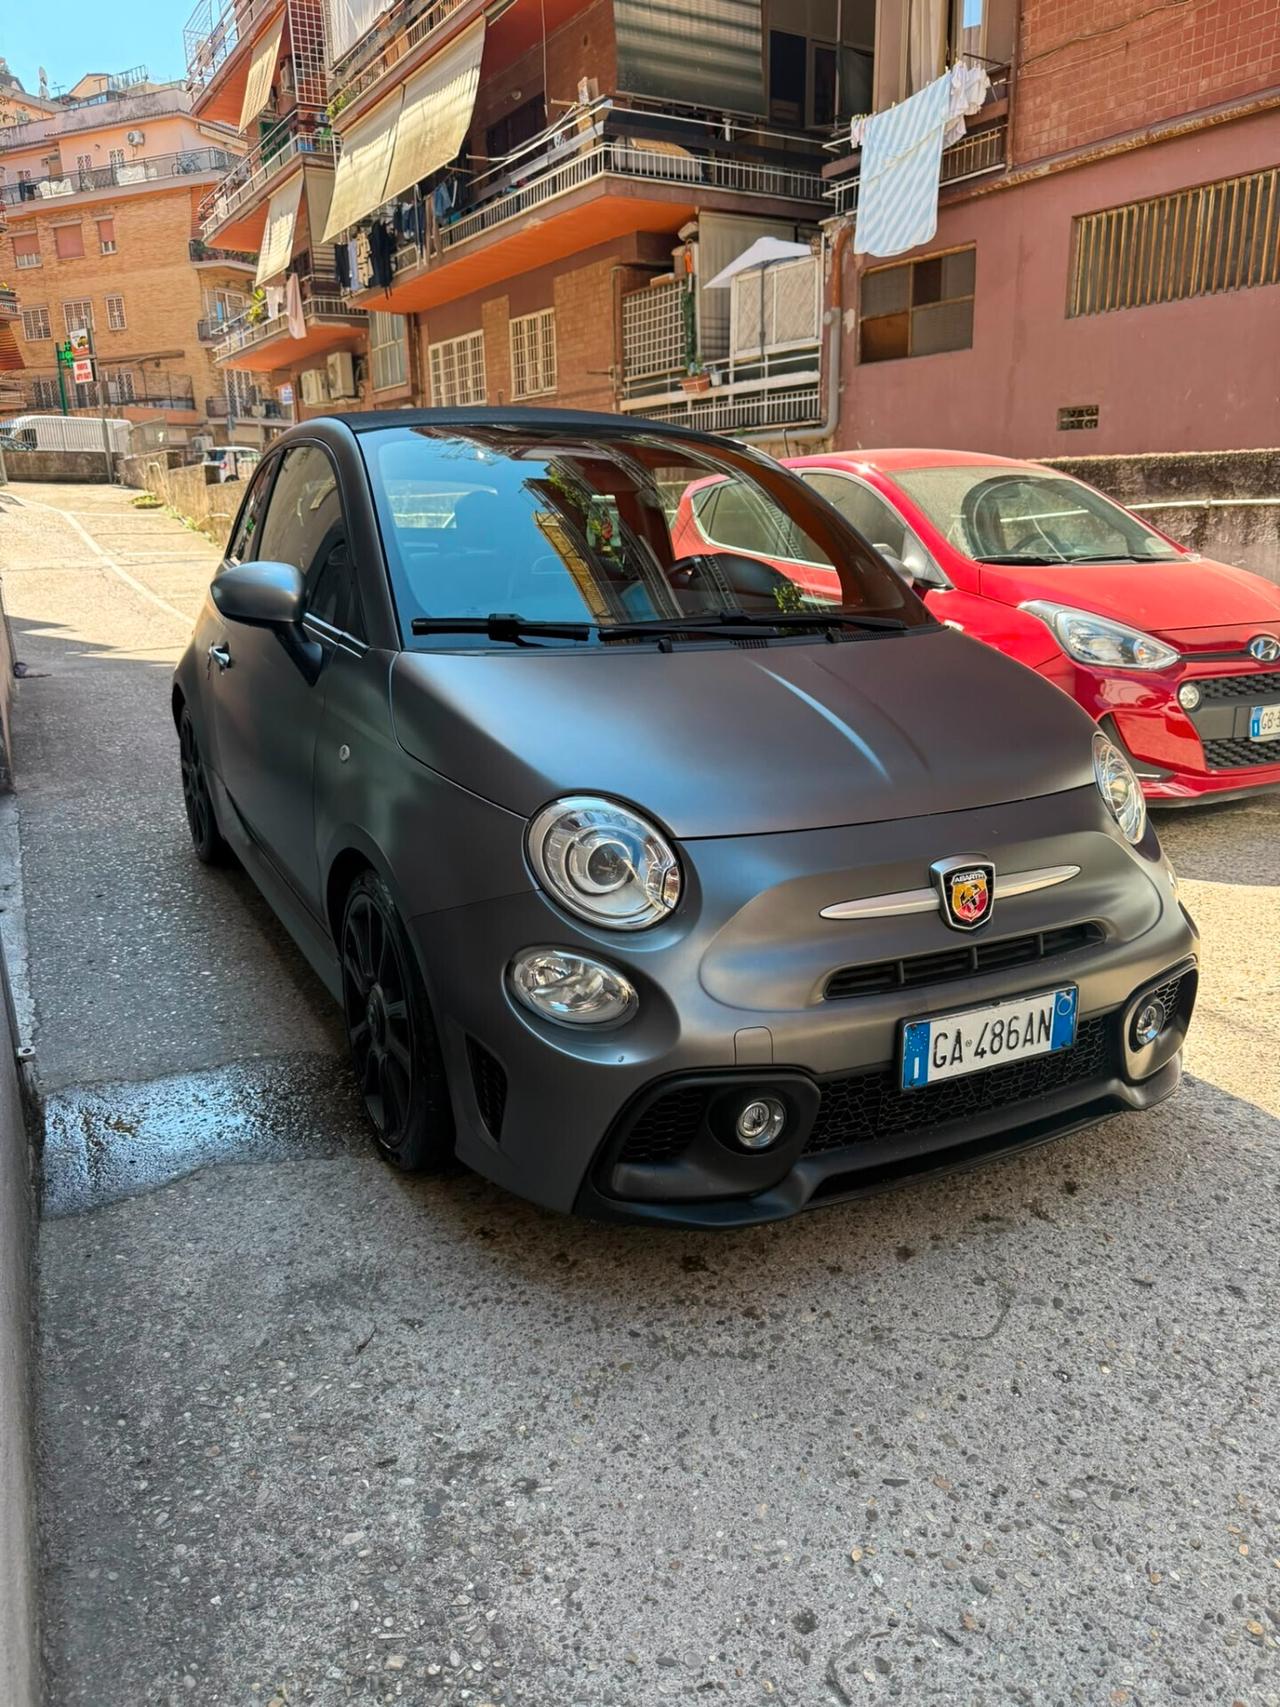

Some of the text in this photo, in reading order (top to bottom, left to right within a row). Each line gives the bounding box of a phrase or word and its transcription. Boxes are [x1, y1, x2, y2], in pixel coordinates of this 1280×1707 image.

[954, 872, 985, 884] ABARTH
[932, 1028, 964, 1069] GA
[973, 1006, 1054, 1059] 486AN
